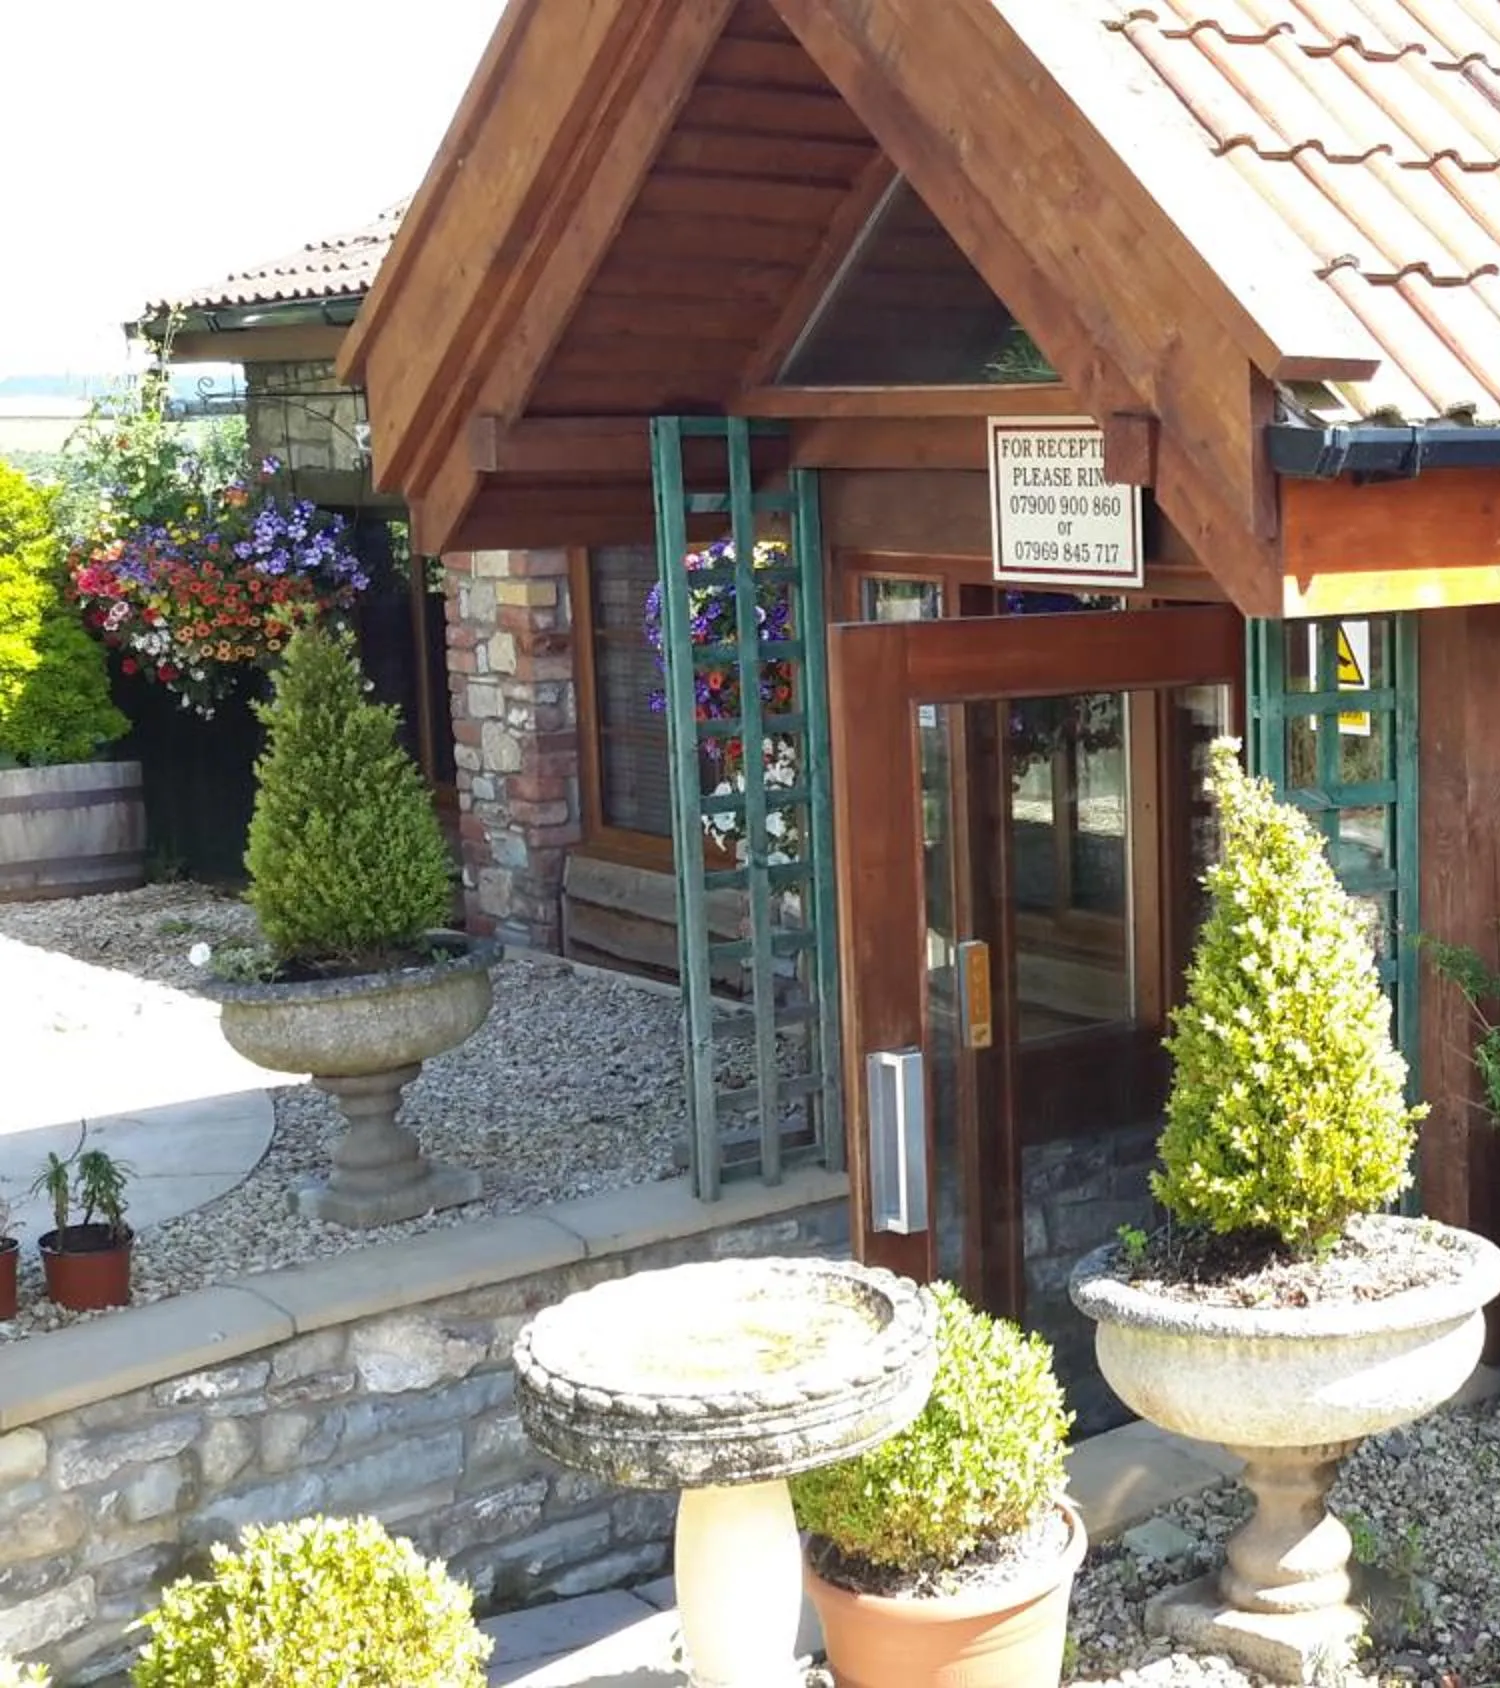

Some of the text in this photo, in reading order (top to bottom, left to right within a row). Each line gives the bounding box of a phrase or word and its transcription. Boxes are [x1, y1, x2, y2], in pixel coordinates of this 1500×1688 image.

[1002, 438, 1104, 459] FOR RECEPTI
[1013, 467, 1112, 488] PLEASE RIN
[1010, 495, 1121, 516] 07900 900 860
[1057, 521, 1072, 535] or
[1015, 541, 1119, 564] 07969 845 717
